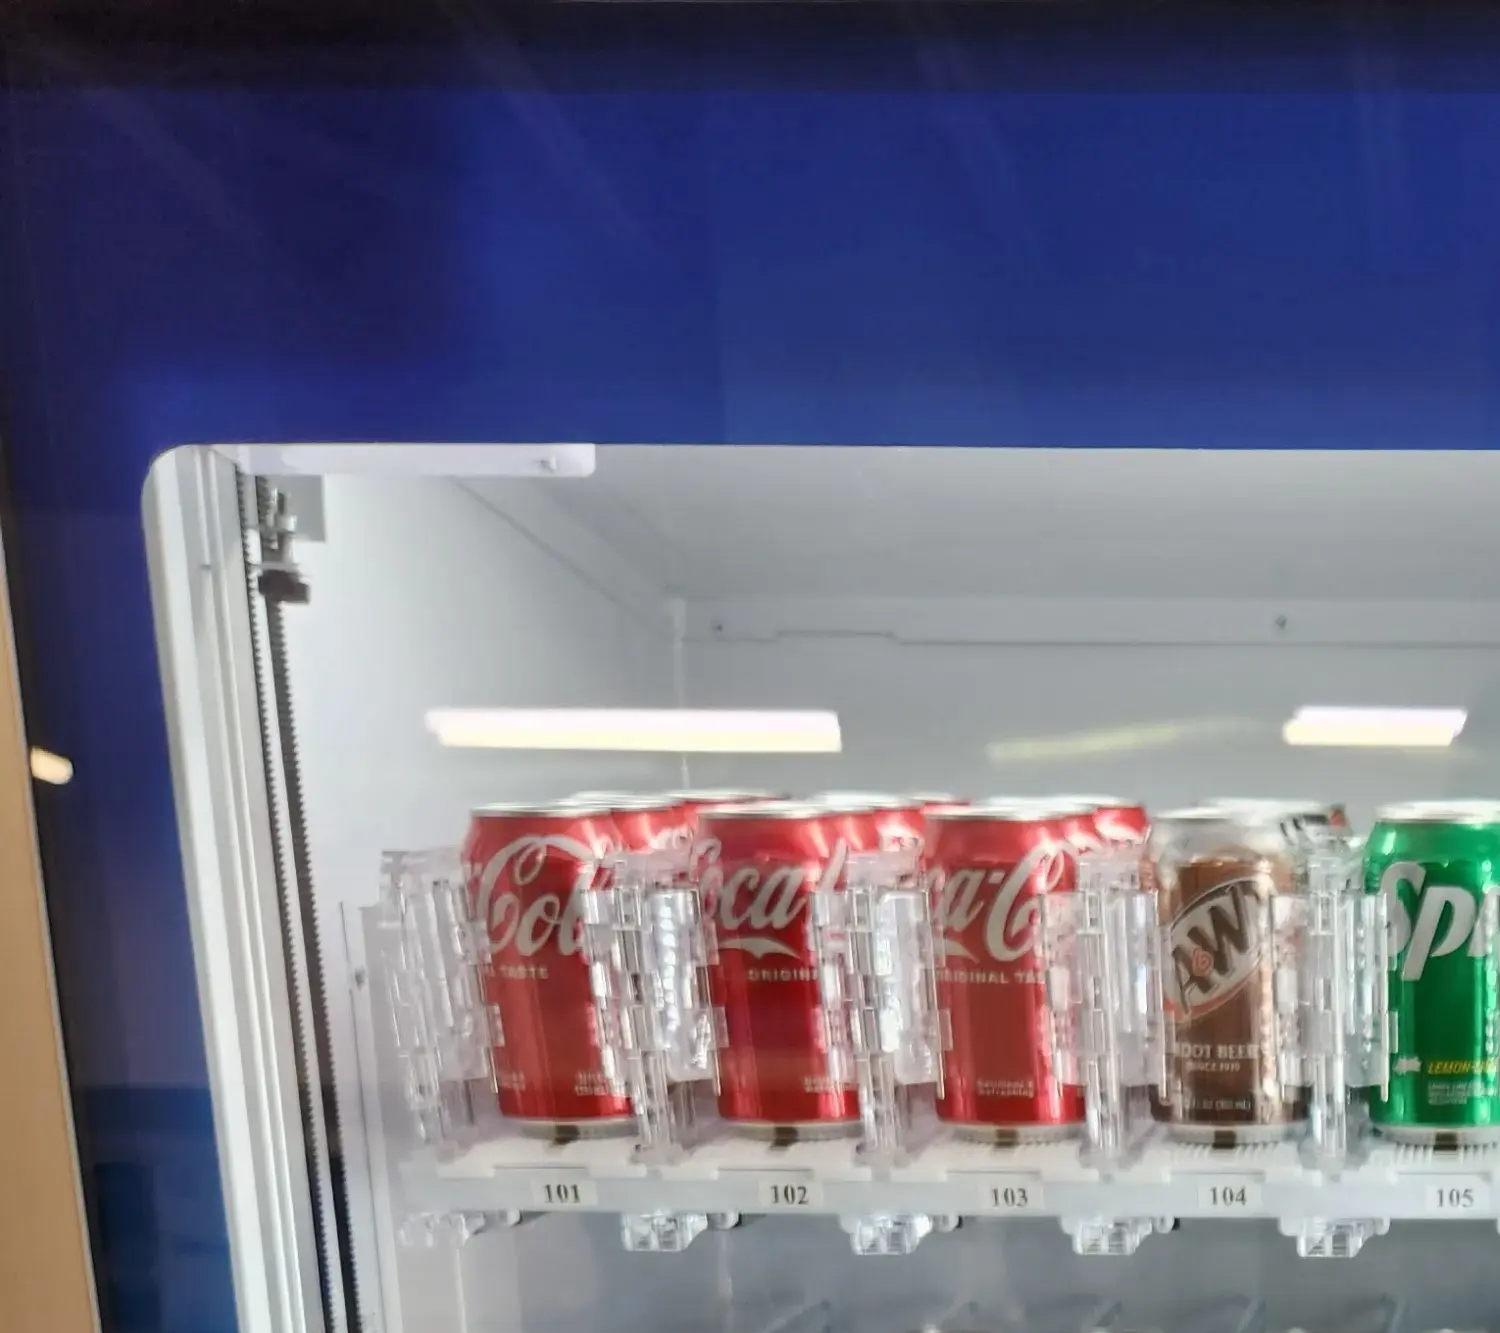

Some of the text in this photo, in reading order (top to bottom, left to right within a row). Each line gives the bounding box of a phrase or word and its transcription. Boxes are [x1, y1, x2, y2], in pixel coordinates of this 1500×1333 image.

[546, 1185, 580, 1203] 101
[772, 1186, 807, 1204] 102
[992, 1188, 1028, 1206] 103
[1211, 1188, 1246, 1205] 104
[1437, 1189, 1474, 1207] 105
